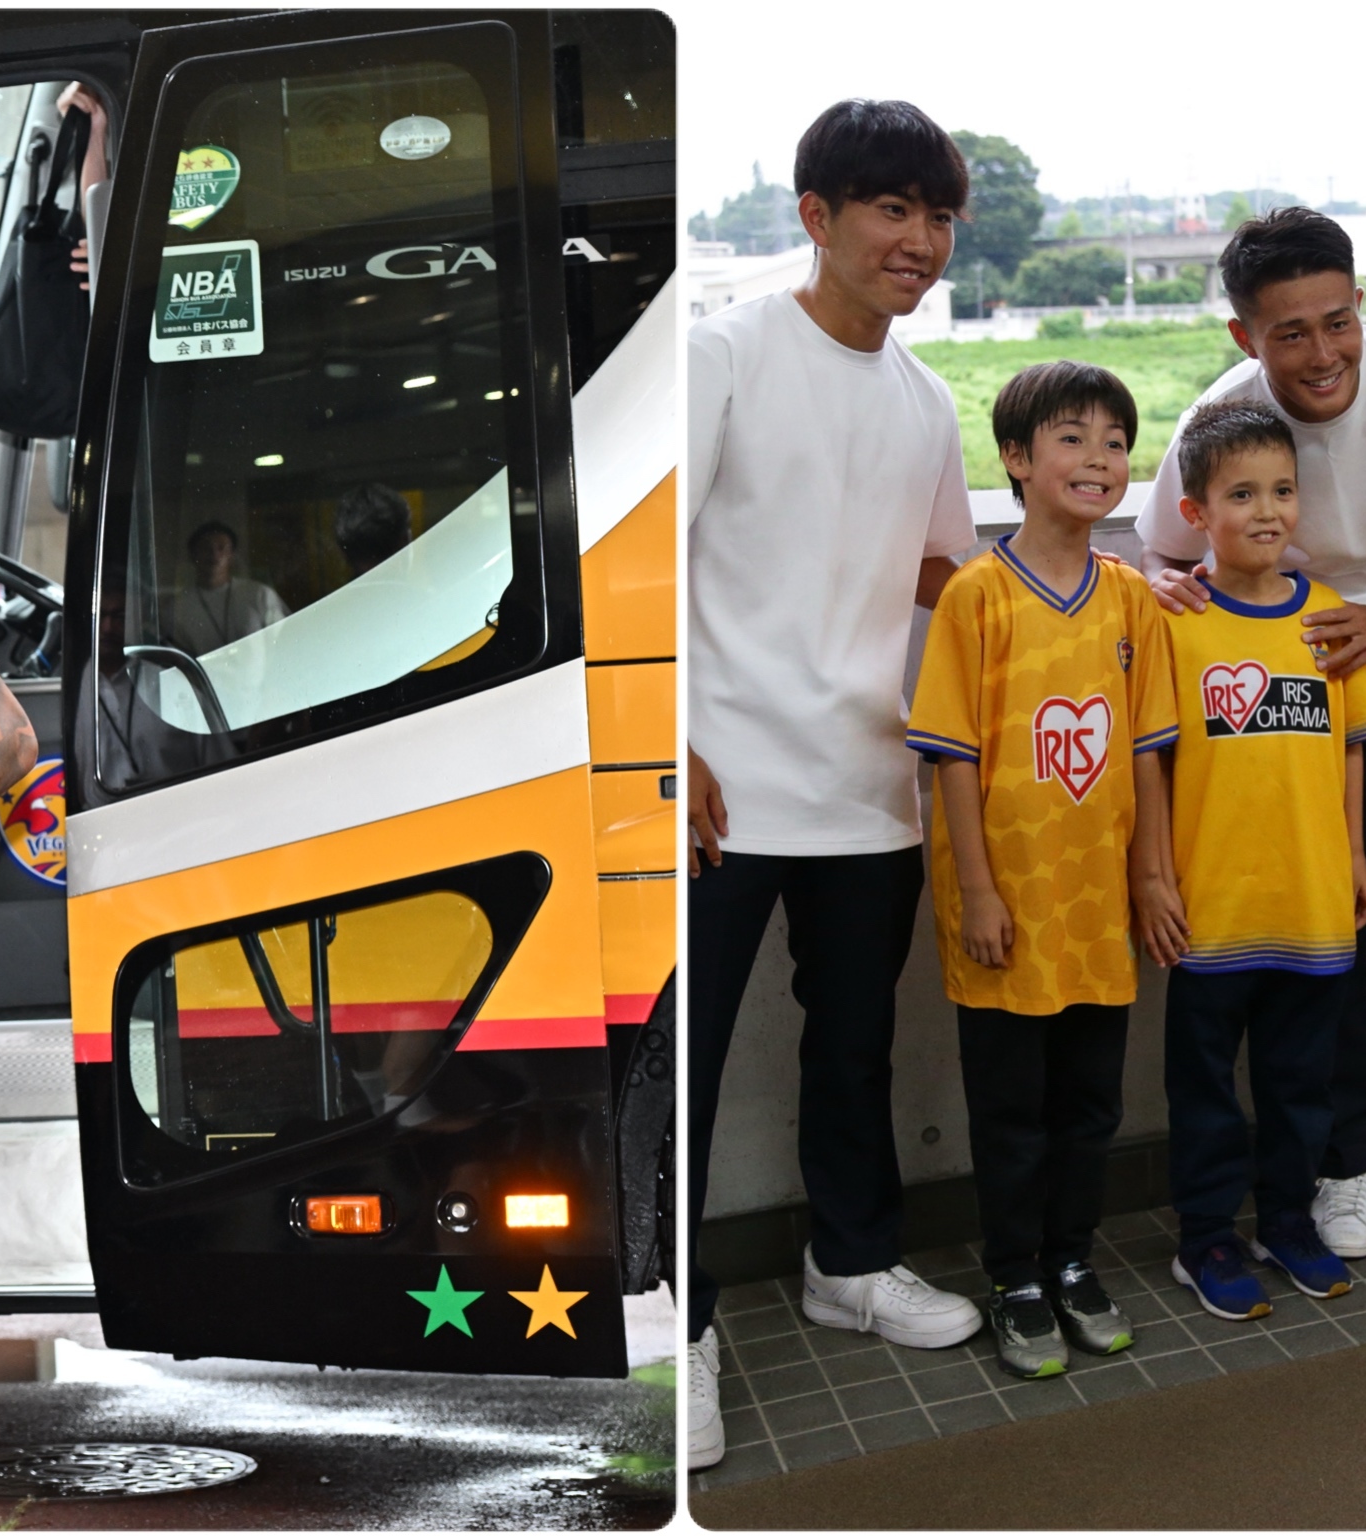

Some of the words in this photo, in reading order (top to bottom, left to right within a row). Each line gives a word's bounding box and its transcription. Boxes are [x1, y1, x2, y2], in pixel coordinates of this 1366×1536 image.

[172, 182, 219, 197] AFETY
[175, 195, 206, 209] BUS
[170, 268, 237, 298] NBA
[284, 265, 347, 281] ISUZU
[193, 318, 249, 332] 日本バス協会
[176, 337, 237, 356] 会員章
[1203, 682, 1247, 717] IRIS
[1282, 681, 1312, 704] IRIS
[1256, 705, 1330, 729] OHYAMA
[1035, 727, 1095, 780] IRIS
